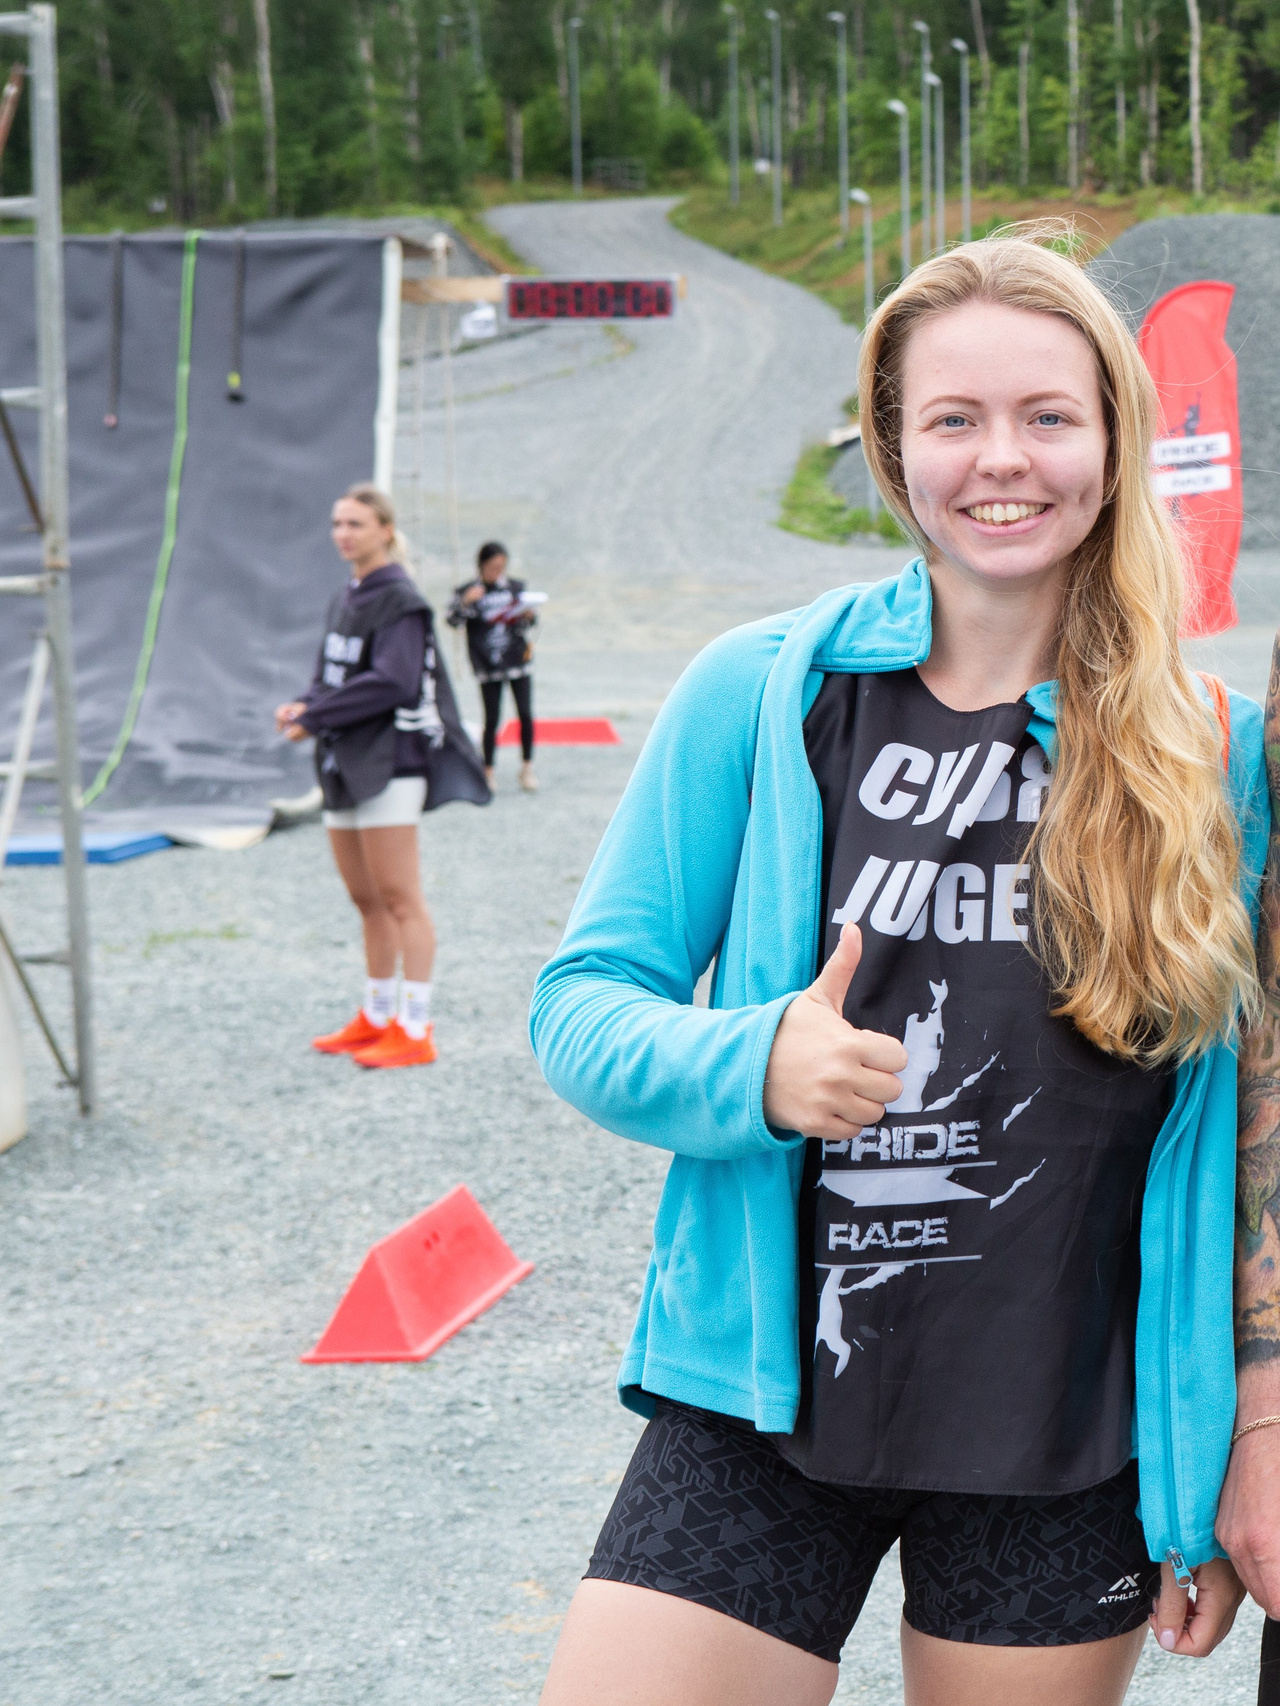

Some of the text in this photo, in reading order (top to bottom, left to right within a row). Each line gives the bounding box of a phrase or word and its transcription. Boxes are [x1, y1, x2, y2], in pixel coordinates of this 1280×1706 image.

[832, 855, 1031, 944] JUGE
[822, 1119, 981, 1162] PRIDE
[828, 1216, 949, 1251] RACE
[1097, 1589, 1141, 1604] ATHLEX
